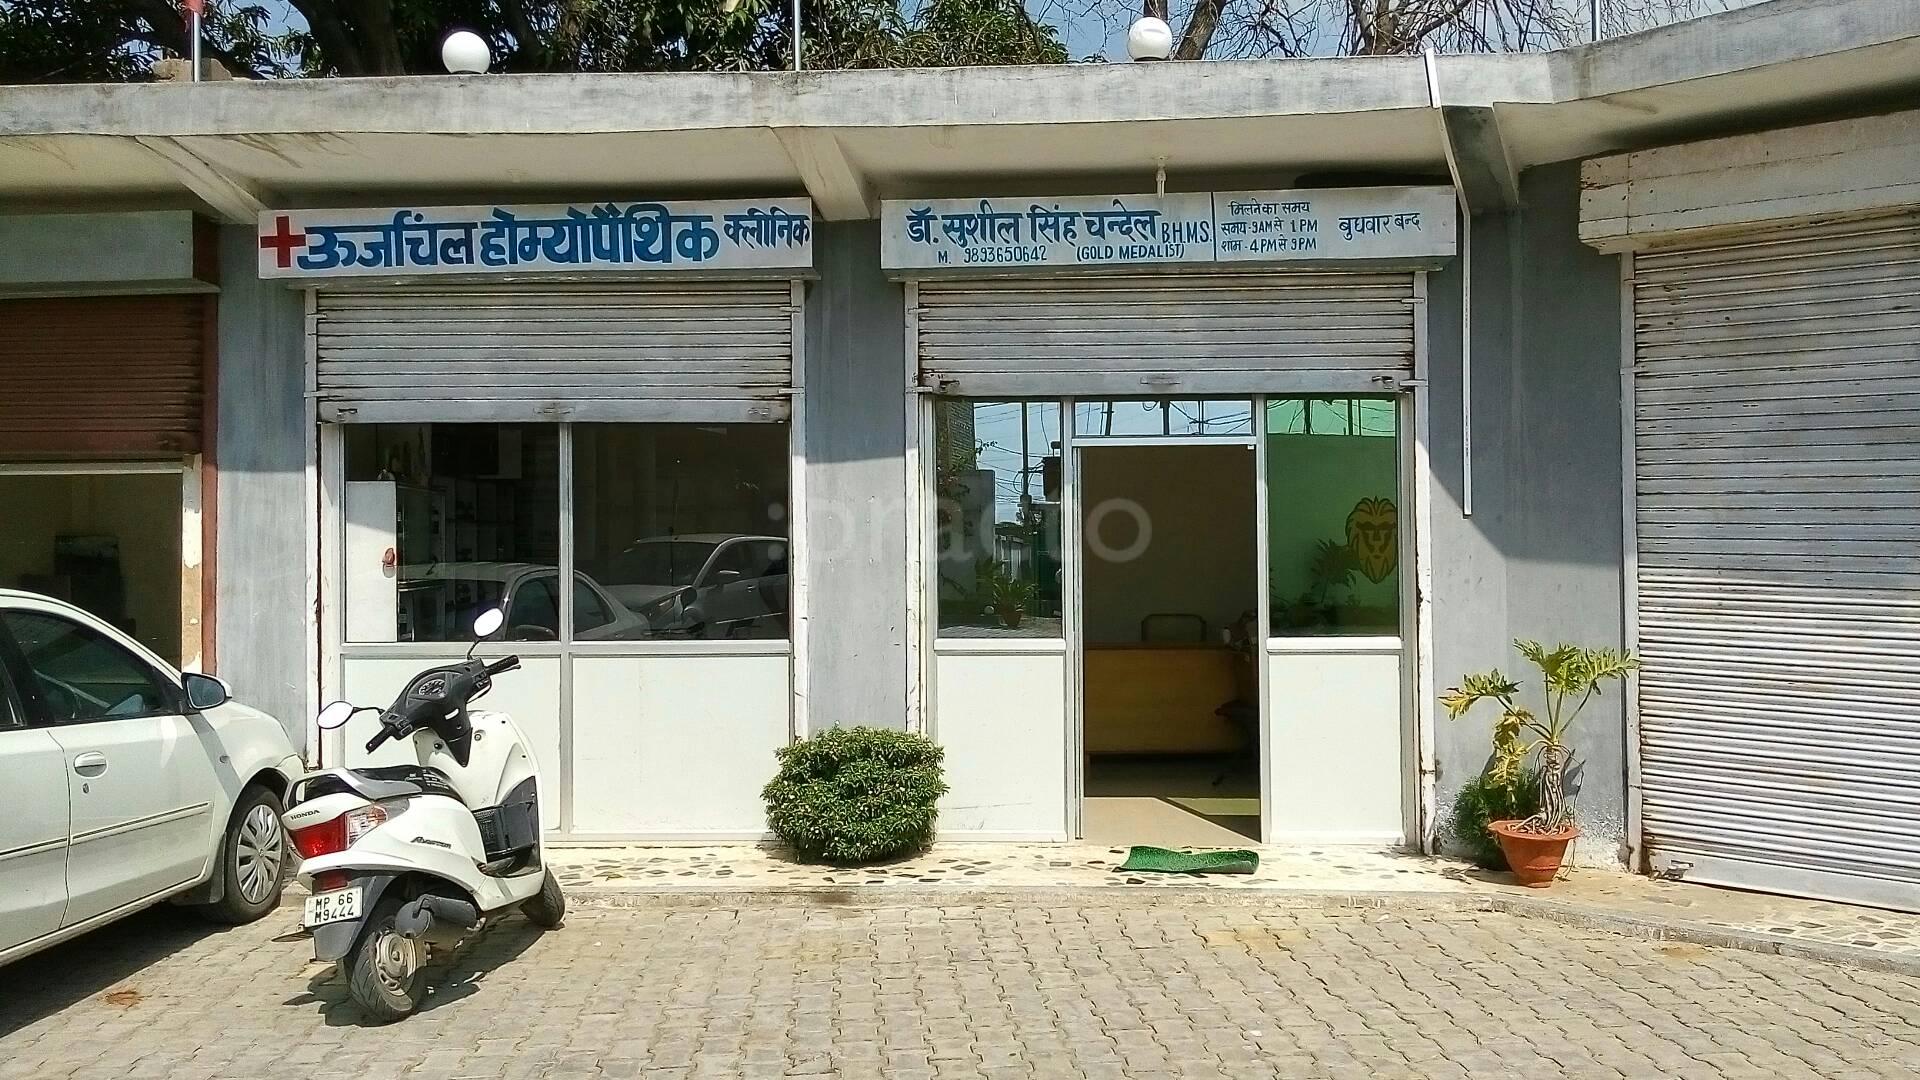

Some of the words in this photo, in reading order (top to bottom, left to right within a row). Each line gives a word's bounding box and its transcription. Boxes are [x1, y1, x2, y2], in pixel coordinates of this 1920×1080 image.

[1281, 202, 1311, 214] समय
[723, 206, 811, 249] क्लीनिक
[941, 199, 1023, 248] सुशील
[1026, 204, 1081, 247] सिंह
[1083, 199, 1161, 242] चन्देल
[1339, 215, 1392, 241] बुधवार
[1395, 212, 1422, 231] बन्द
[963, 245, 1048, 263] 9893650642
[1076, 246, 1113, 263] (GOLD
[1119, 243, 1185, 260] MEDALIST)
[290, 809, 320, 821] HONDA
[315, 896, 331, 911] MP
[338, 892, 353, 906] 66
[314, 905, 354, 924] M9444
